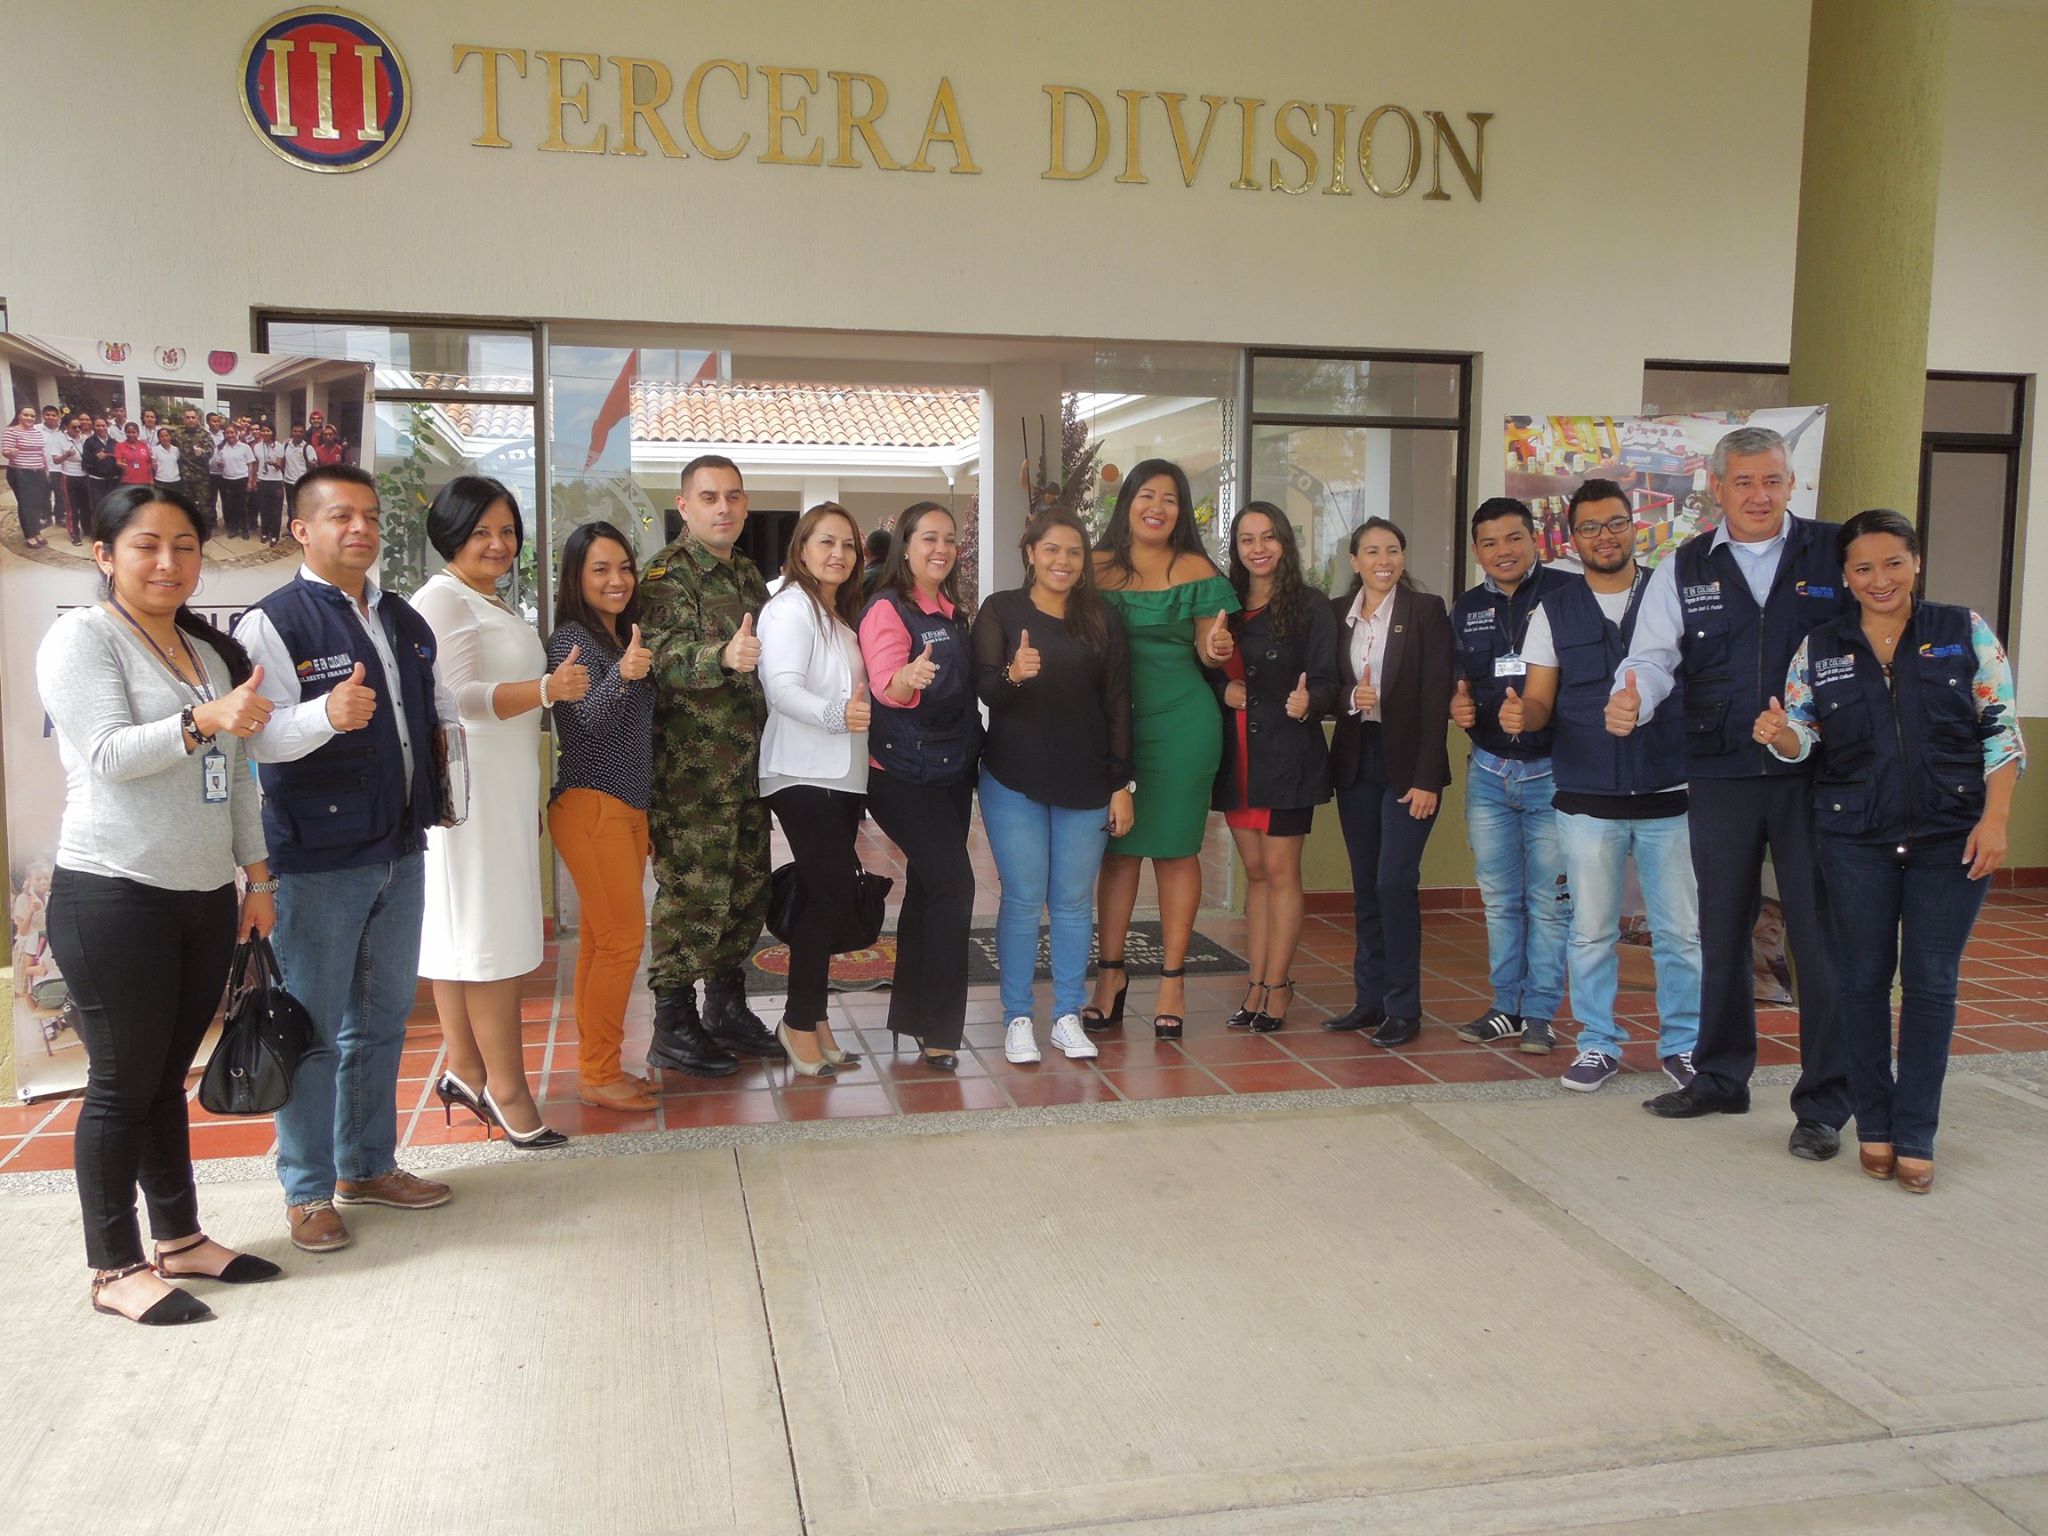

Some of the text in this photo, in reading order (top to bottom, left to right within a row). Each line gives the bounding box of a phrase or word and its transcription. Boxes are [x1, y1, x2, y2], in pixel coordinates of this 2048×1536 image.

[266, 39, 385, 141] III
[452, 43, 1495, 202] TERCERA DIVISION
